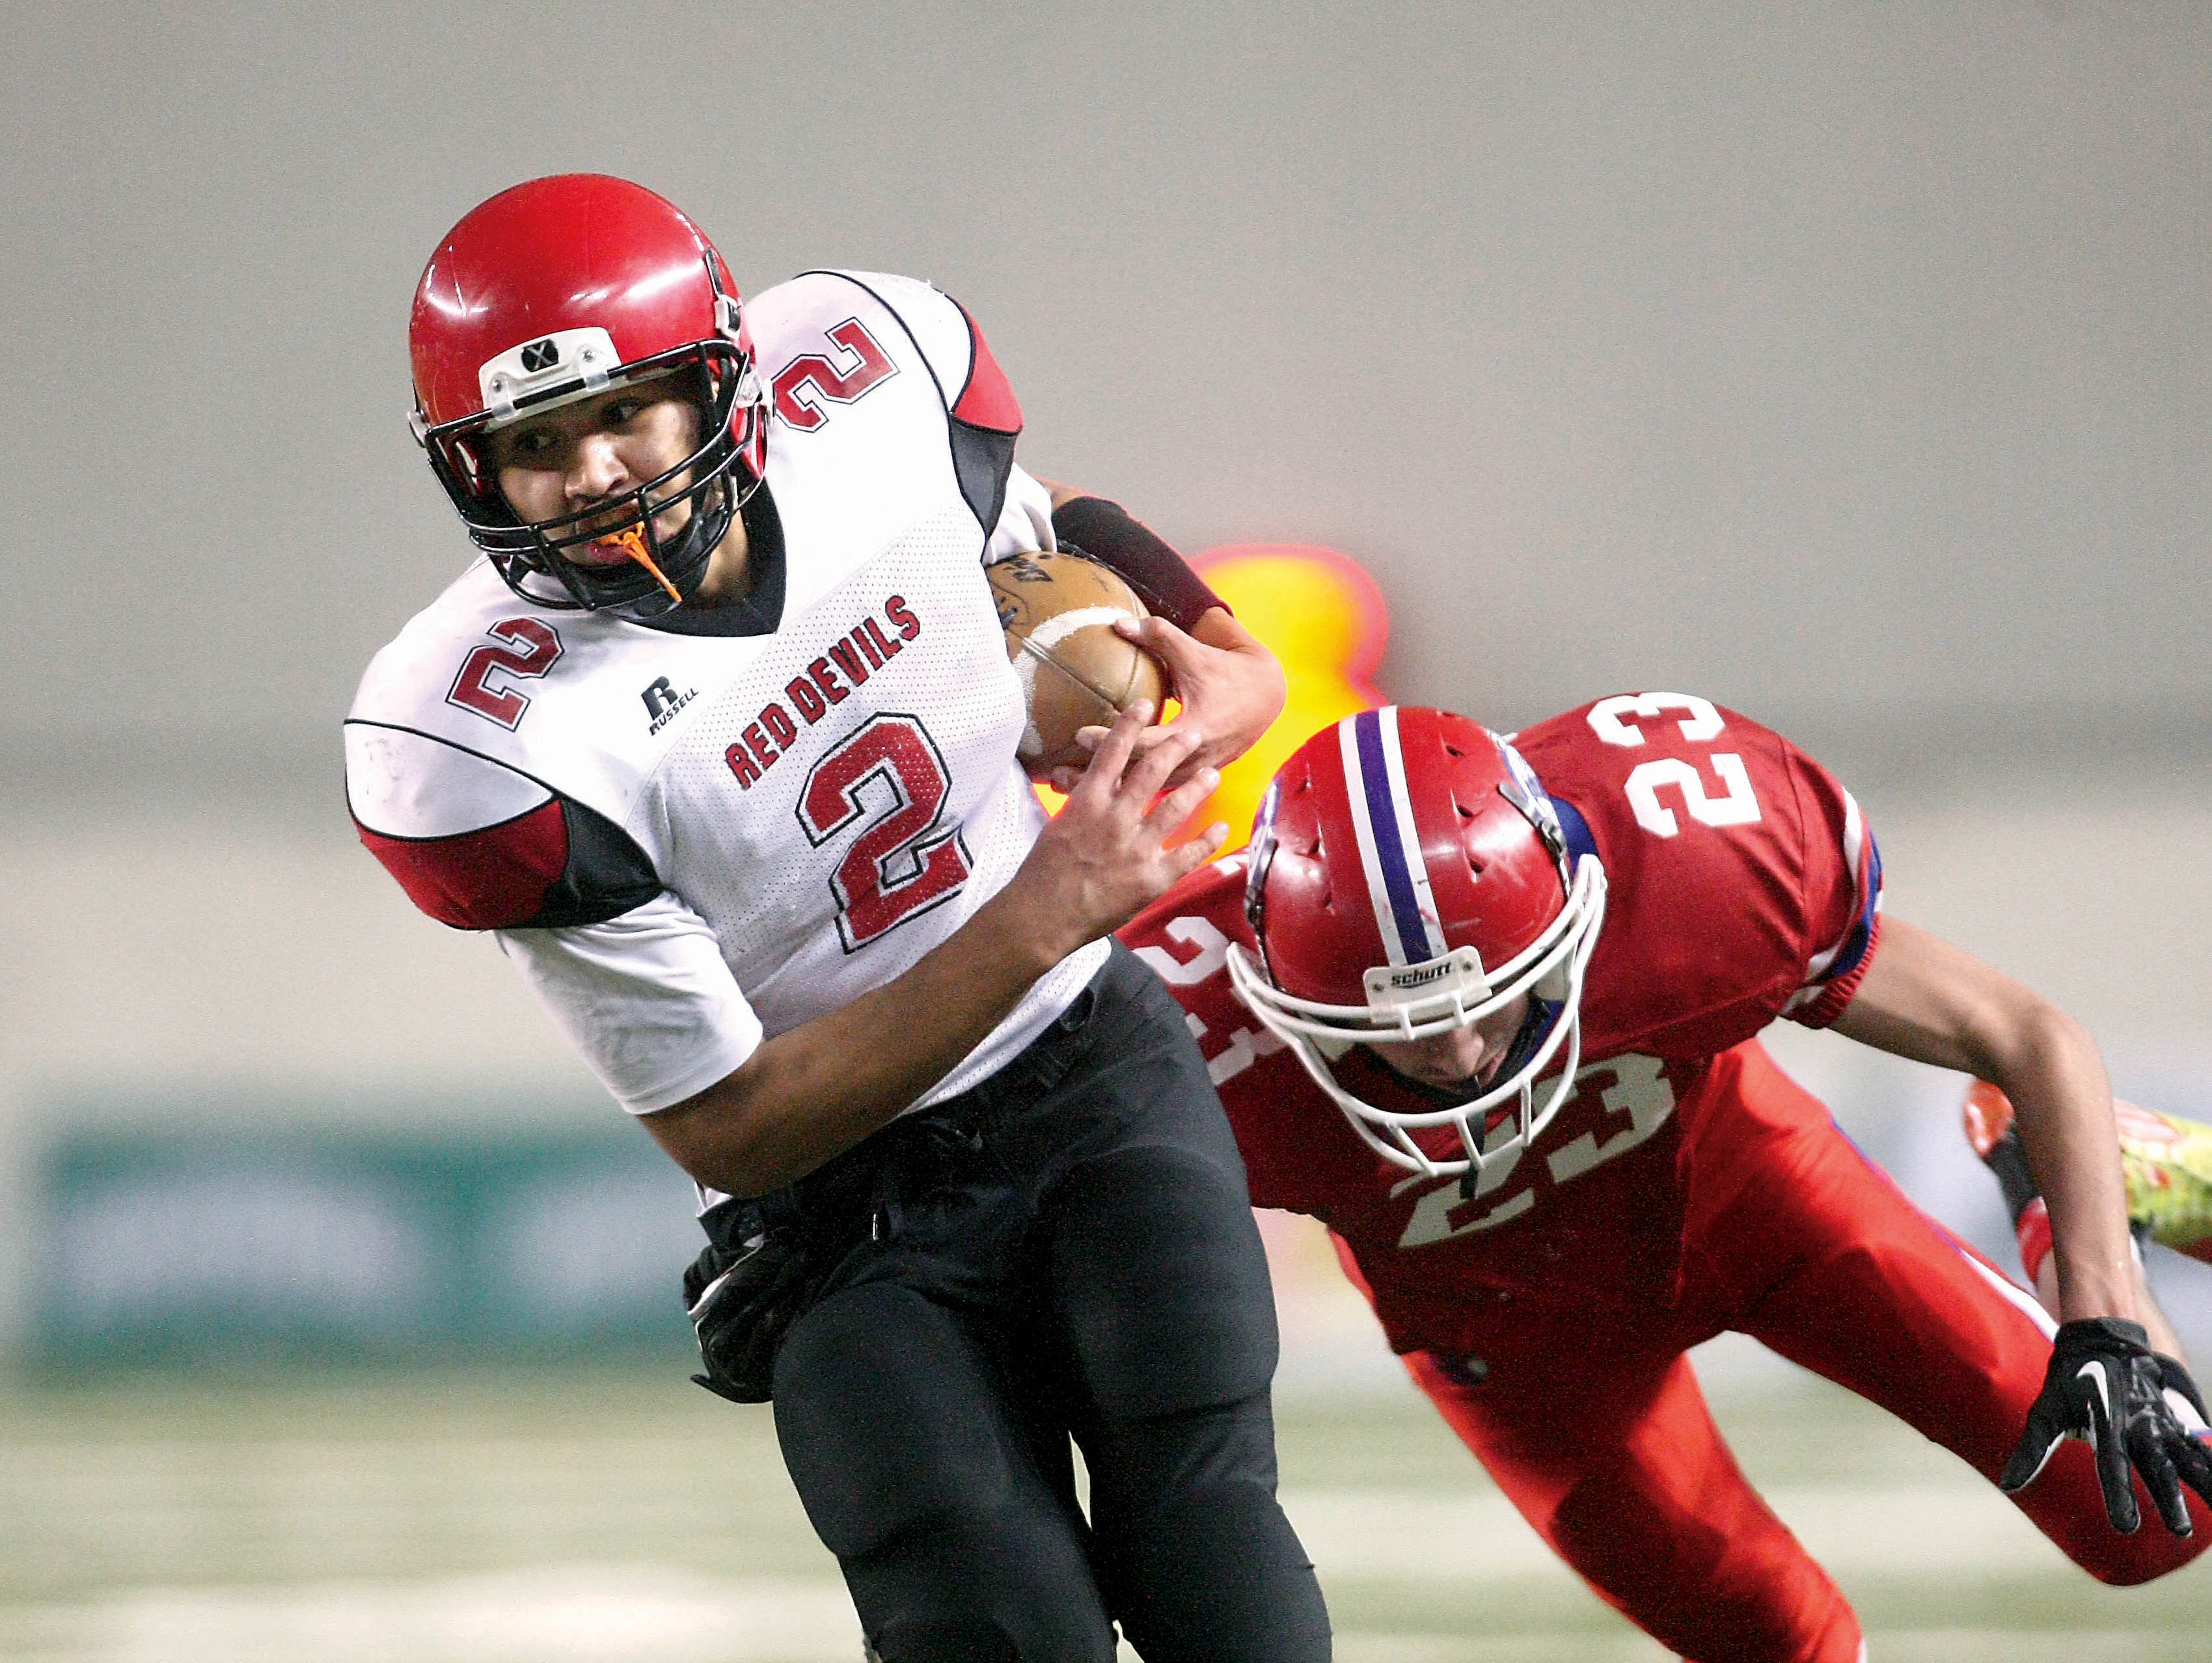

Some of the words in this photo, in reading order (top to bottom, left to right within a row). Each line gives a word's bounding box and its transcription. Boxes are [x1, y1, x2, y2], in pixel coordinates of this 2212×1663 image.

[772, 317, 900, 433] 2
[445, 616, 565, 733] 2
[649, 688, 700, 737] RUSSELL
[724, 703, 799, 791] RED
[785, 595, 921, 725] DEVILS
[1586, 691, 1762, 839] 23
[795, 711, 974, 955] 2
